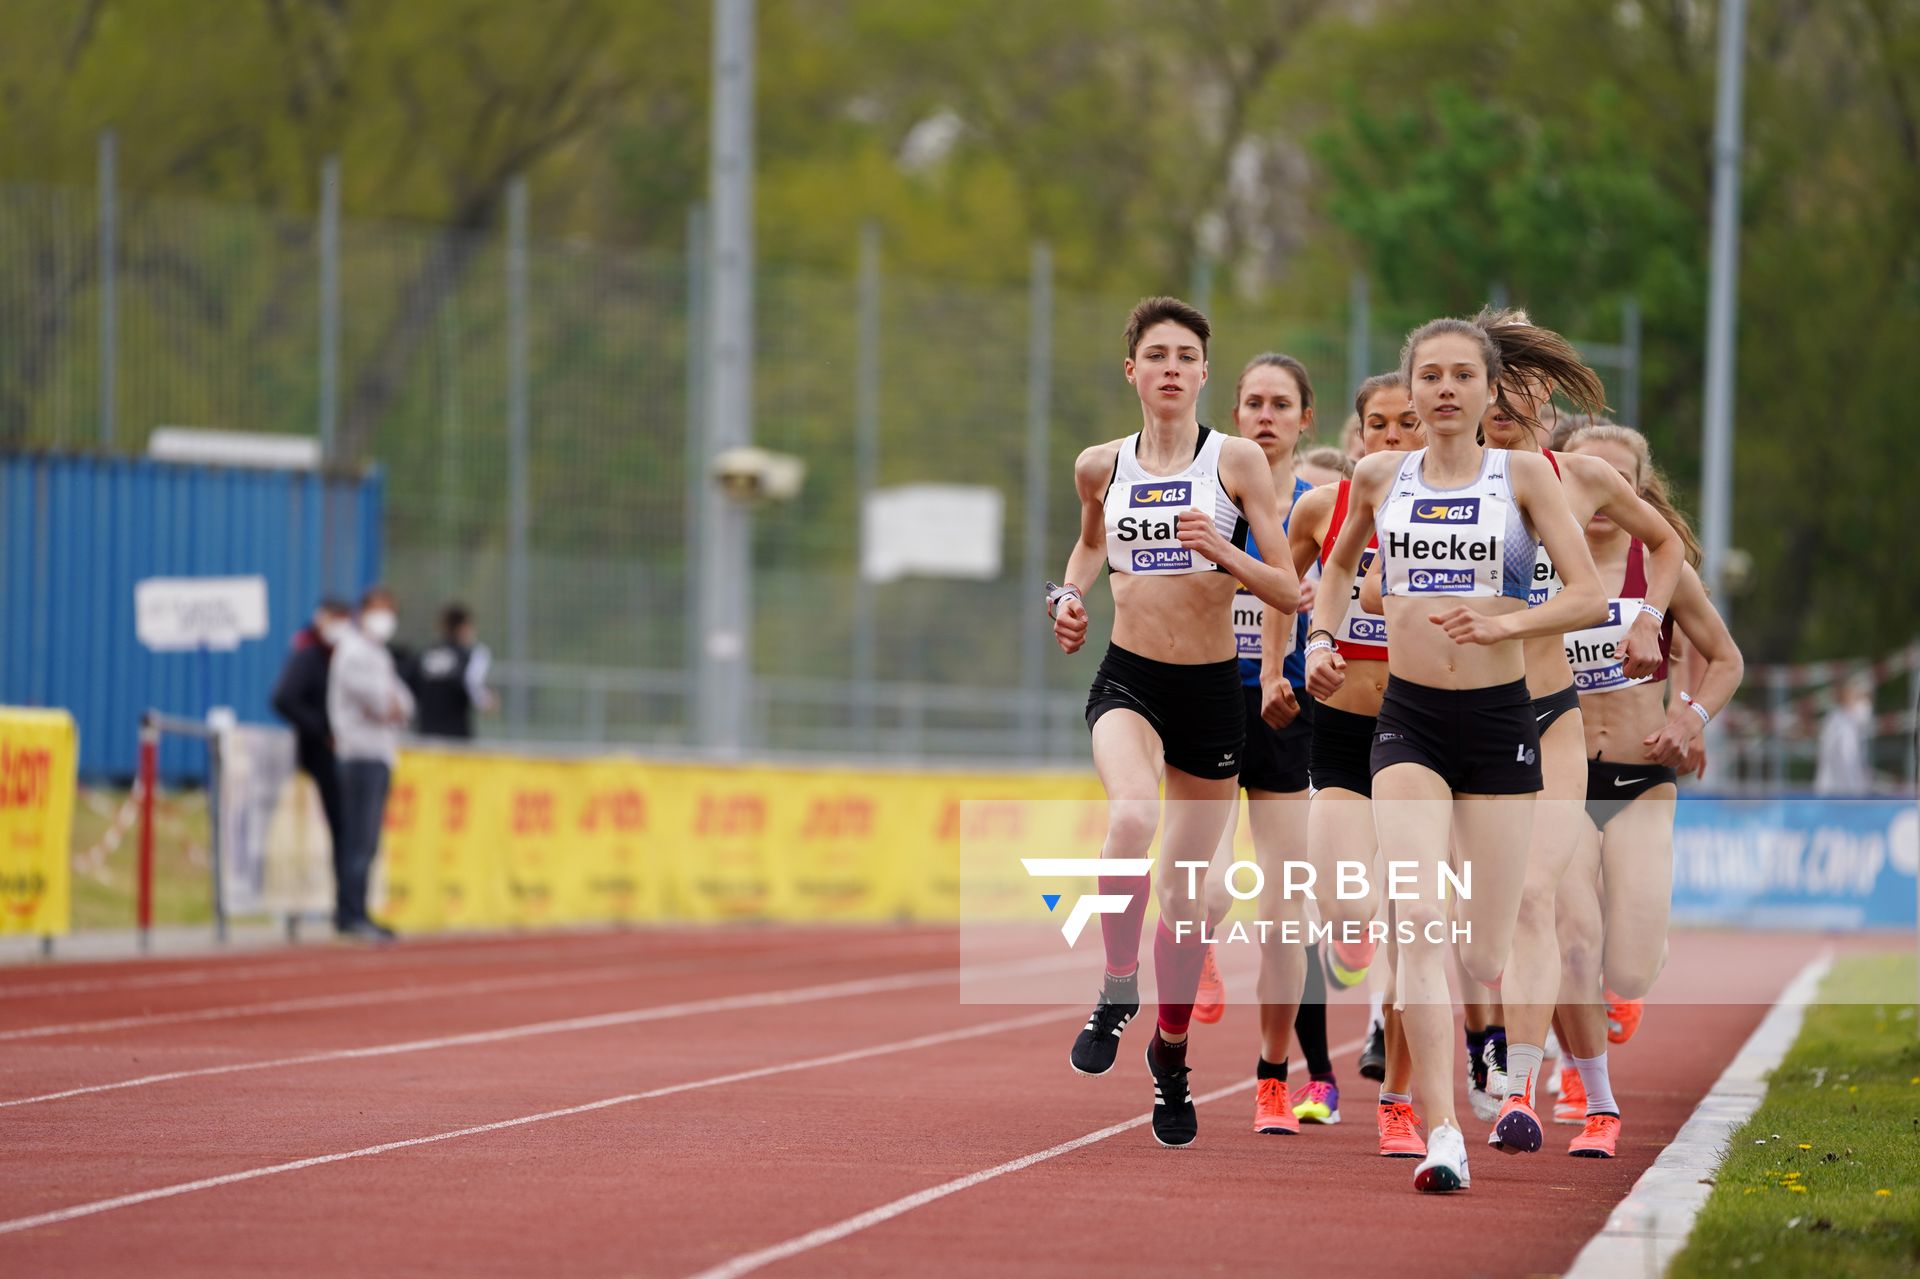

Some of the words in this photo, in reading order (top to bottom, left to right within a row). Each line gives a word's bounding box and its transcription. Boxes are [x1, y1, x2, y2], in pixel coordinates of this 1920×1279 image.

[1163, 488, 1186, 502] GLS
[1447, 505, 1473, 520] GLS
[1390, 532, 1496, 561] Heckel
[1157, 551, 1189, 562] PLAN
[1434, 573, 1472, 584] PLAN
